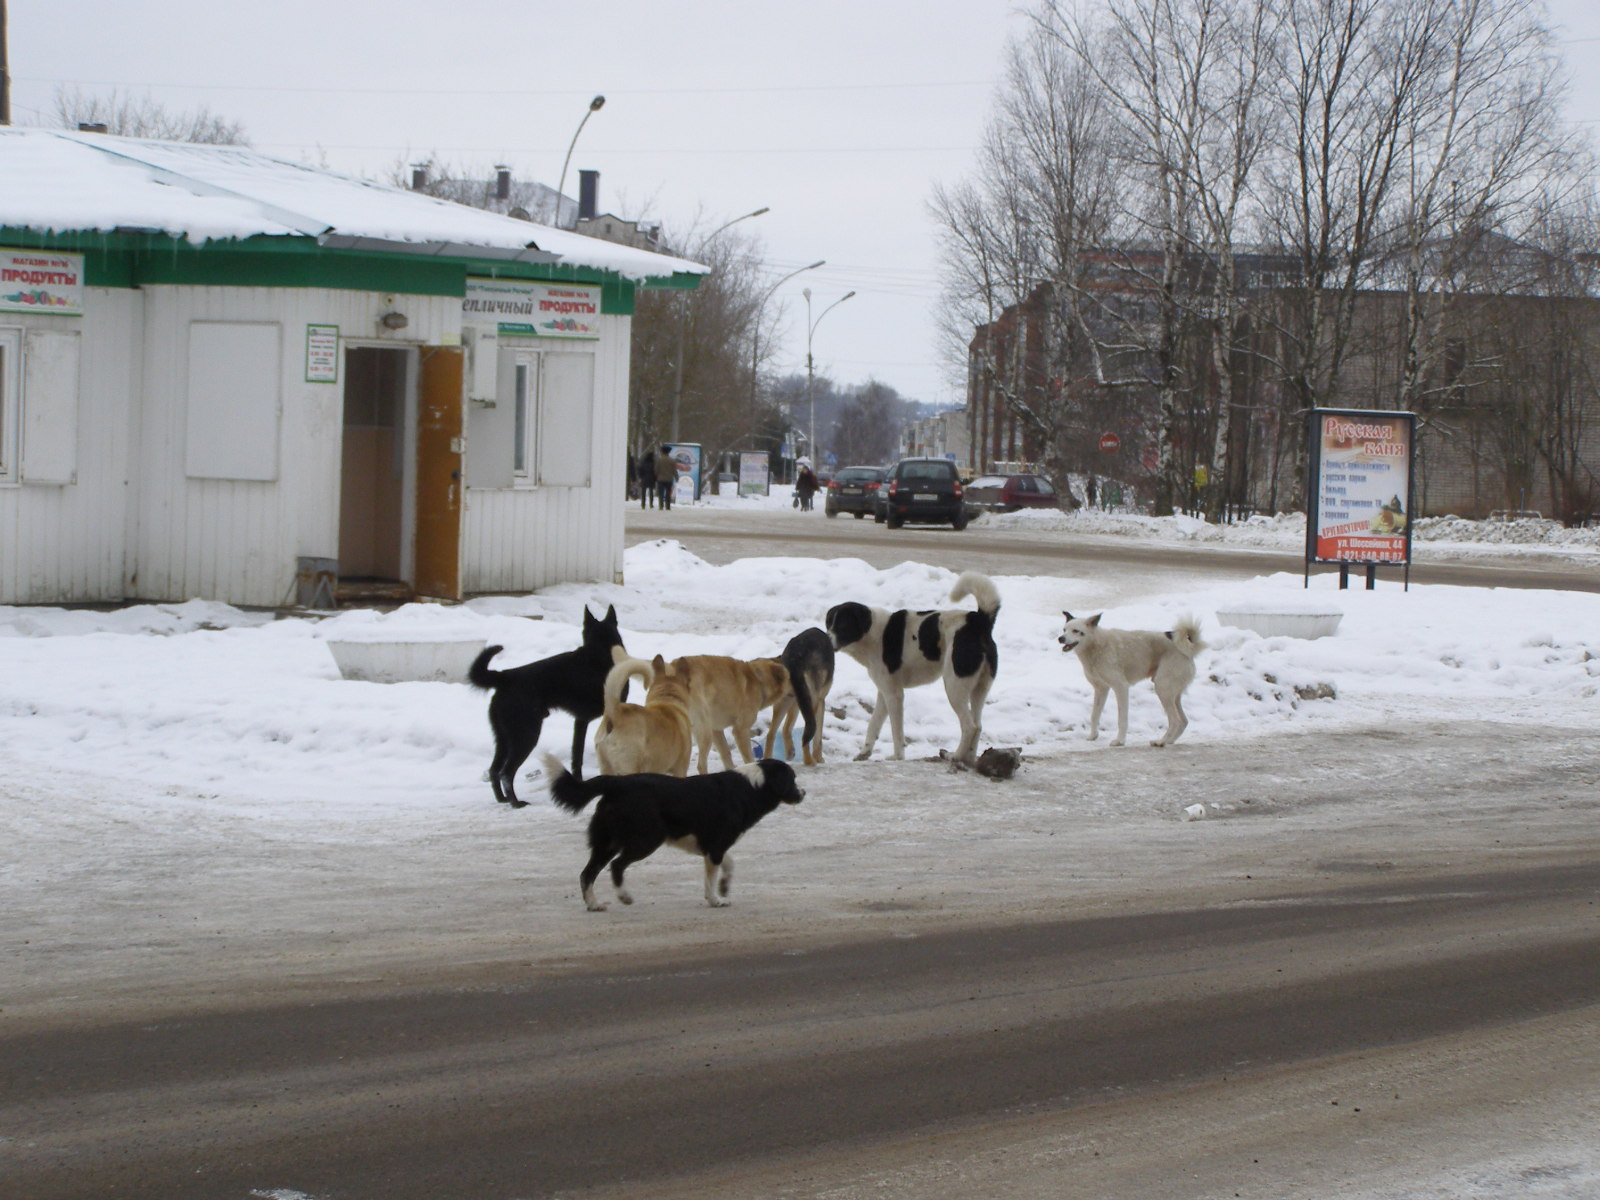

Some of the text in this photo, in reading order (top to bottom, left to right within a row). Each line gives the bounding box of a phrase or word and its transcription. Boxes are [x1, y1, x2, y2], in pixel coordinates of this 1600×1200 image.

[1, 268, 76, 286] ПРОДУКТЫ
[539, 300, 595, 314] ПРОДУКТЫ
[1325, 417, 1393, 443] Русская
